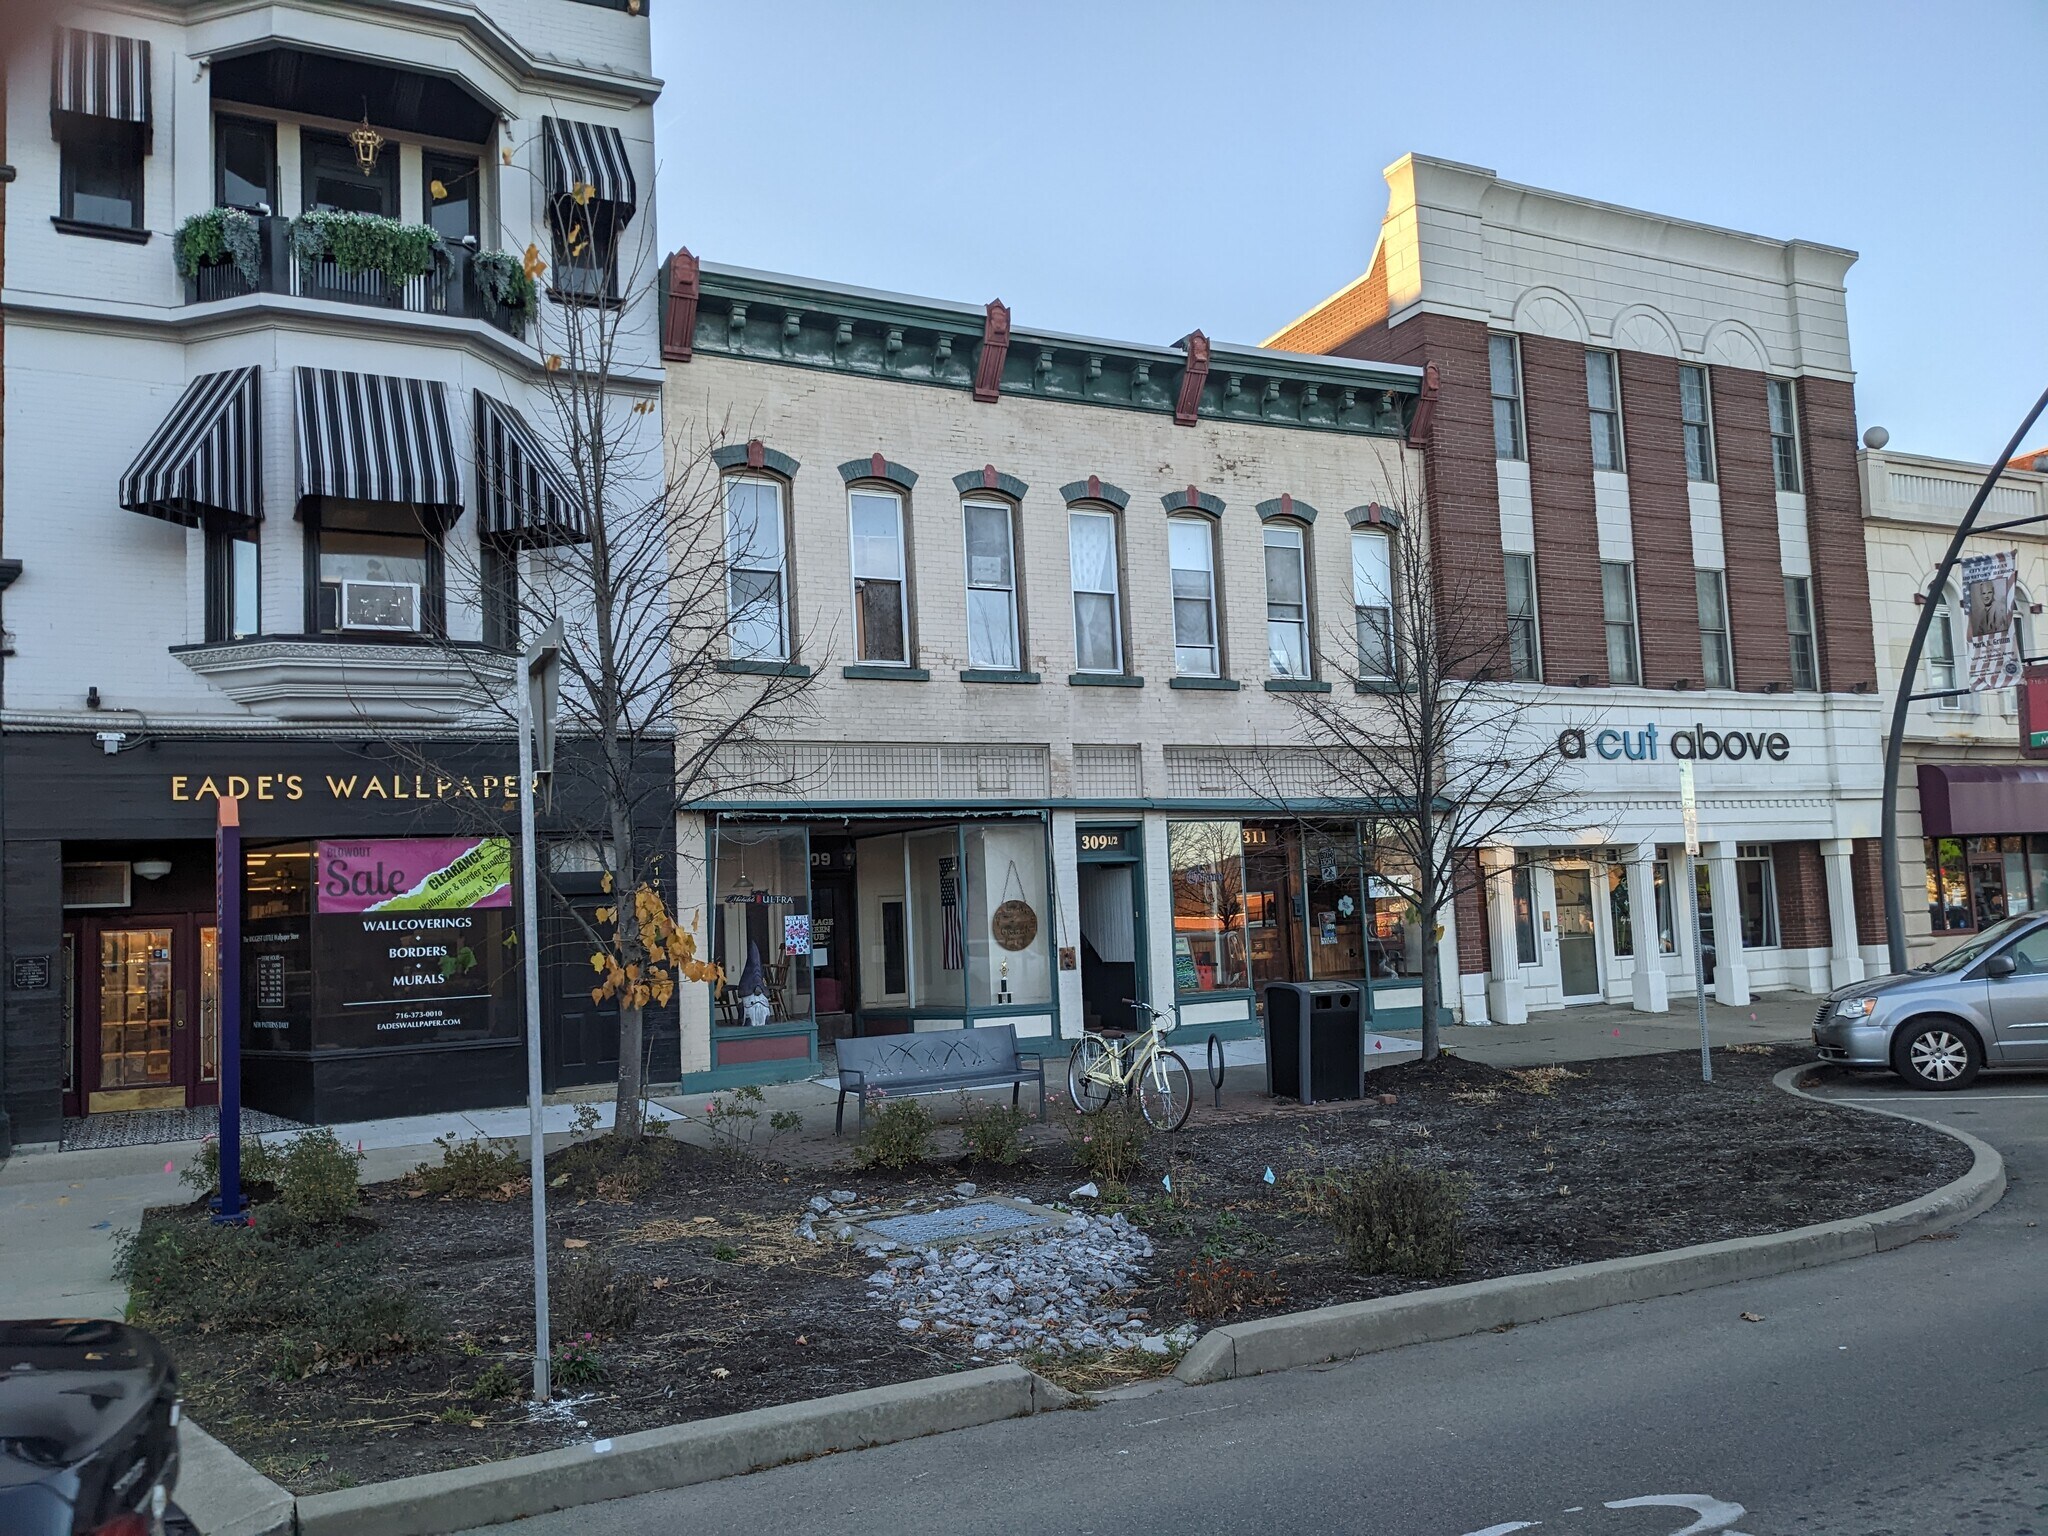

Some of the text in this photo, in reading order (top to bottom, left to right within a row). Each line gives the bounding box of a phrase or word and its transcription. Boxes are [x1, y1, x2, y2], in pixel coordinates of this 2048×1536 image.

[1558, 722, 1790, 760] a cut above
[172, 774, 302, 801] EADE'S
[1242, 831, 1267, 844] 311
[327, 847, 371, 858] BLOWOUT
[810, 852, 831, 866] 09
[428, 849, 484, 890] CLEARANCE
[326, 859, 408, 897] Sale
[419, 887, 453, 911] Wallpaper
[452, 883, 460, 891] &
[458, 869, 481, 887] Border
[455, 873, 497, 907] starting at $5
[762, 895, 794, 904] ULTRA
[363, 917, 472, 932] WALLCOVERINGS
[812, 918, 834, 926] LAGE
[389, 946, 447, 959] BORDERS
[392, 974, 445, 987] MURALS
[396, 1011, 443, 1020] 716-373-0010
[377, 1019, 461, 1031] EADESWALLPAPER.COM
